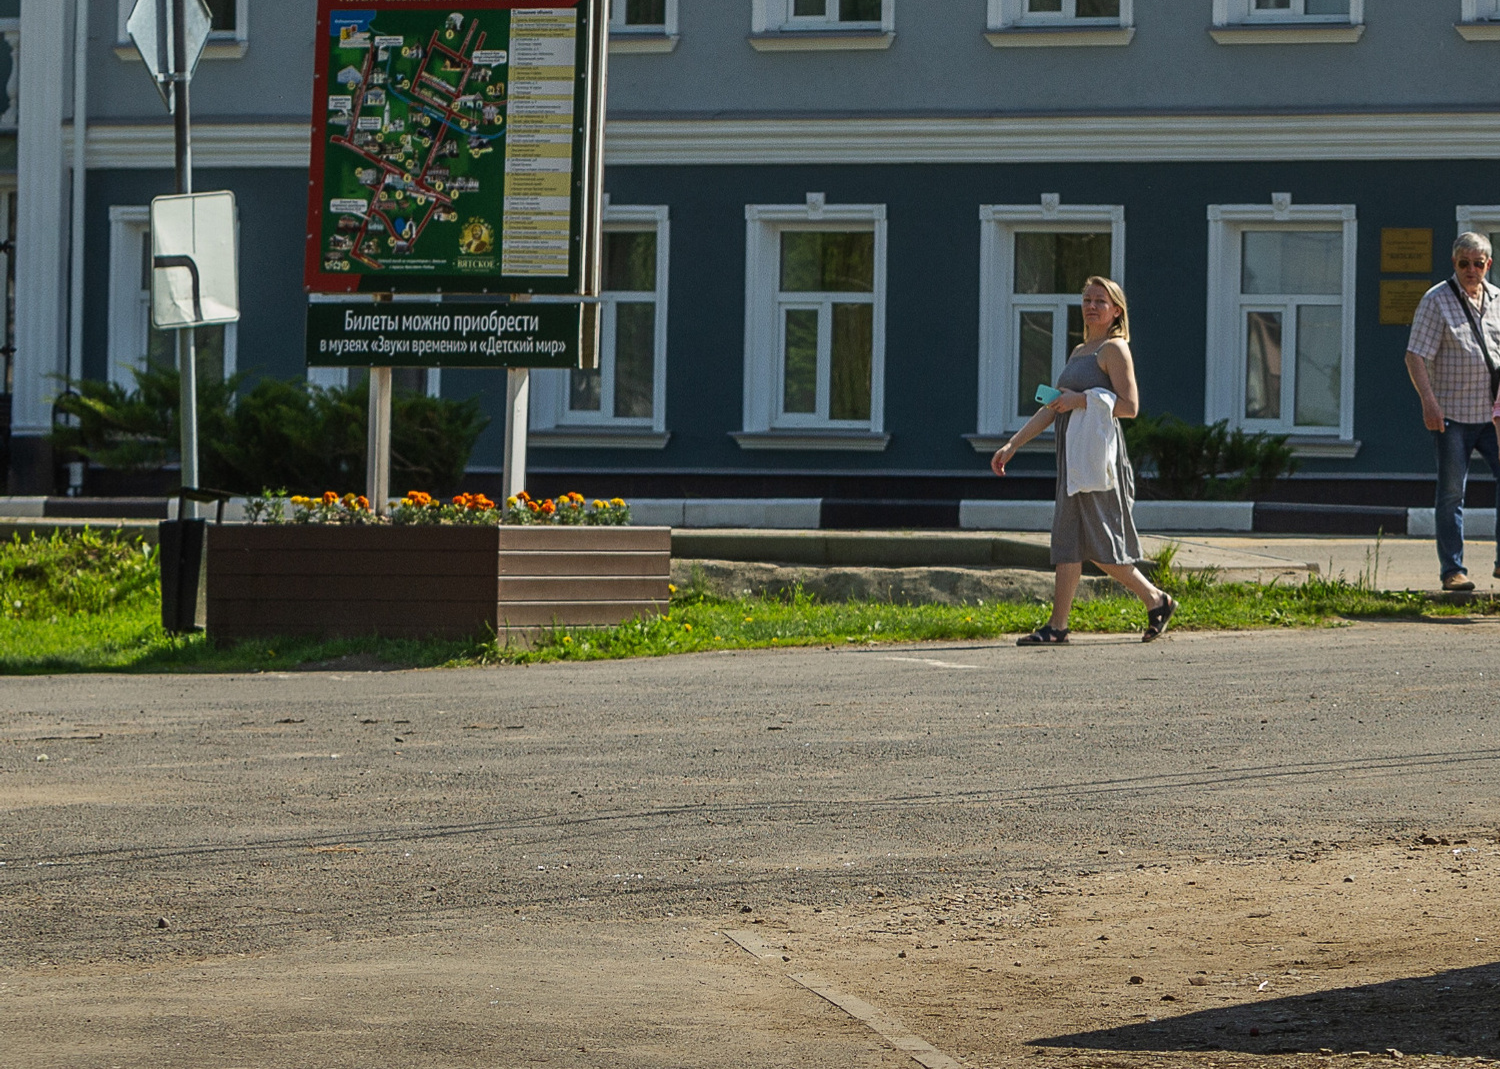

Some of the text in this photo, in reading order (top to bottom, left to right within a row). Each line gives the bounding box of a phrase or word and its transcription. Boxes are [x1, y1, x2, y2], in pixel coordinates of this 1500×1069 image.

[344, 310, 539, 336] Билеты можно приобрести
[319, 335, 567, 357] в музеях «Звуки времени» и «Детский мир»
